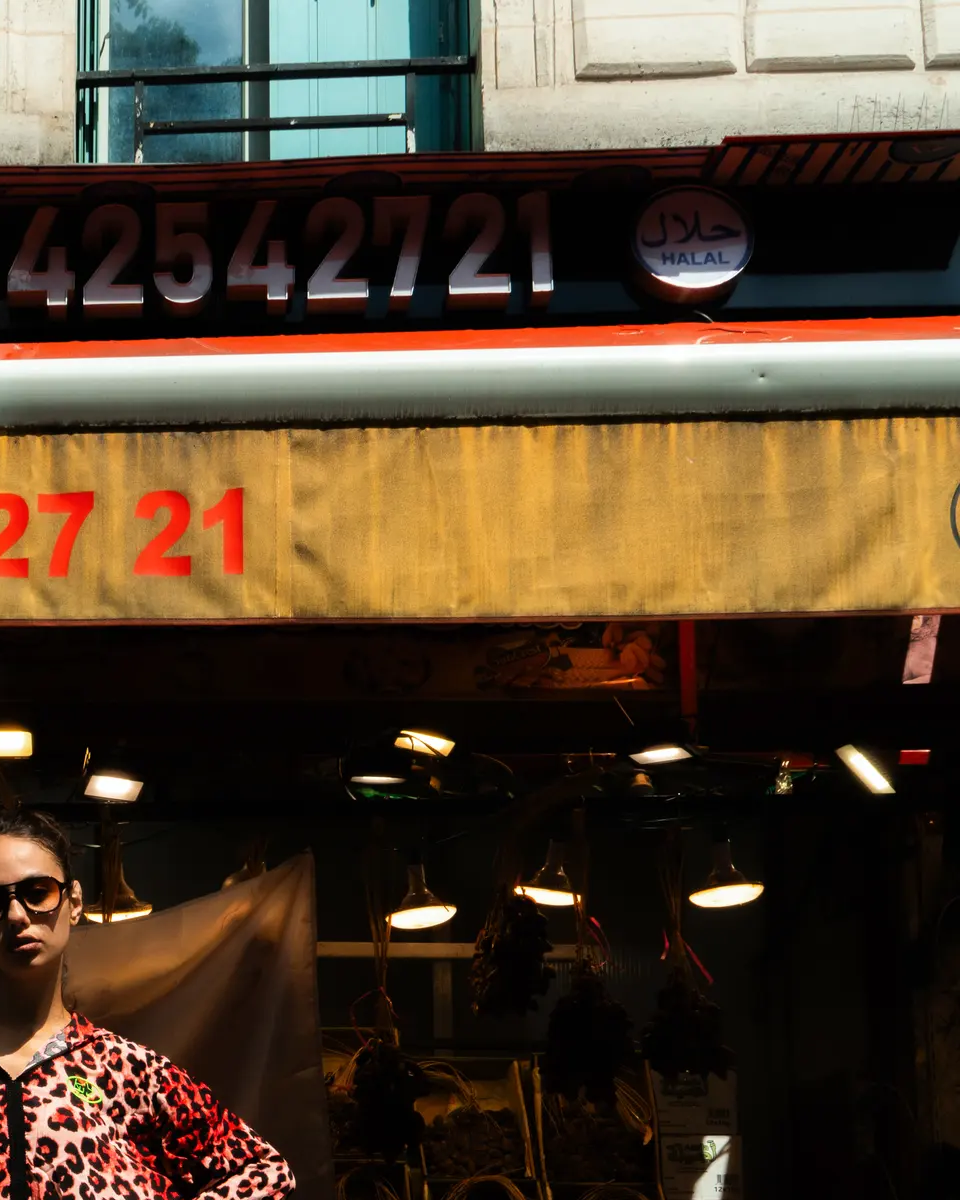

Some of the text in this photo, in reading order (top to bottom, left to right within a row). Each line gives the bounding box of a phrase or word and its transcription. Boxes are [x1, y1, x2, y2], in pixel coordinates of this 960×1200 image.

[642, 210, 741, 248] حلال
[661, 251, 731, 266] HALAL
[132, 487, 245, 577] 21
